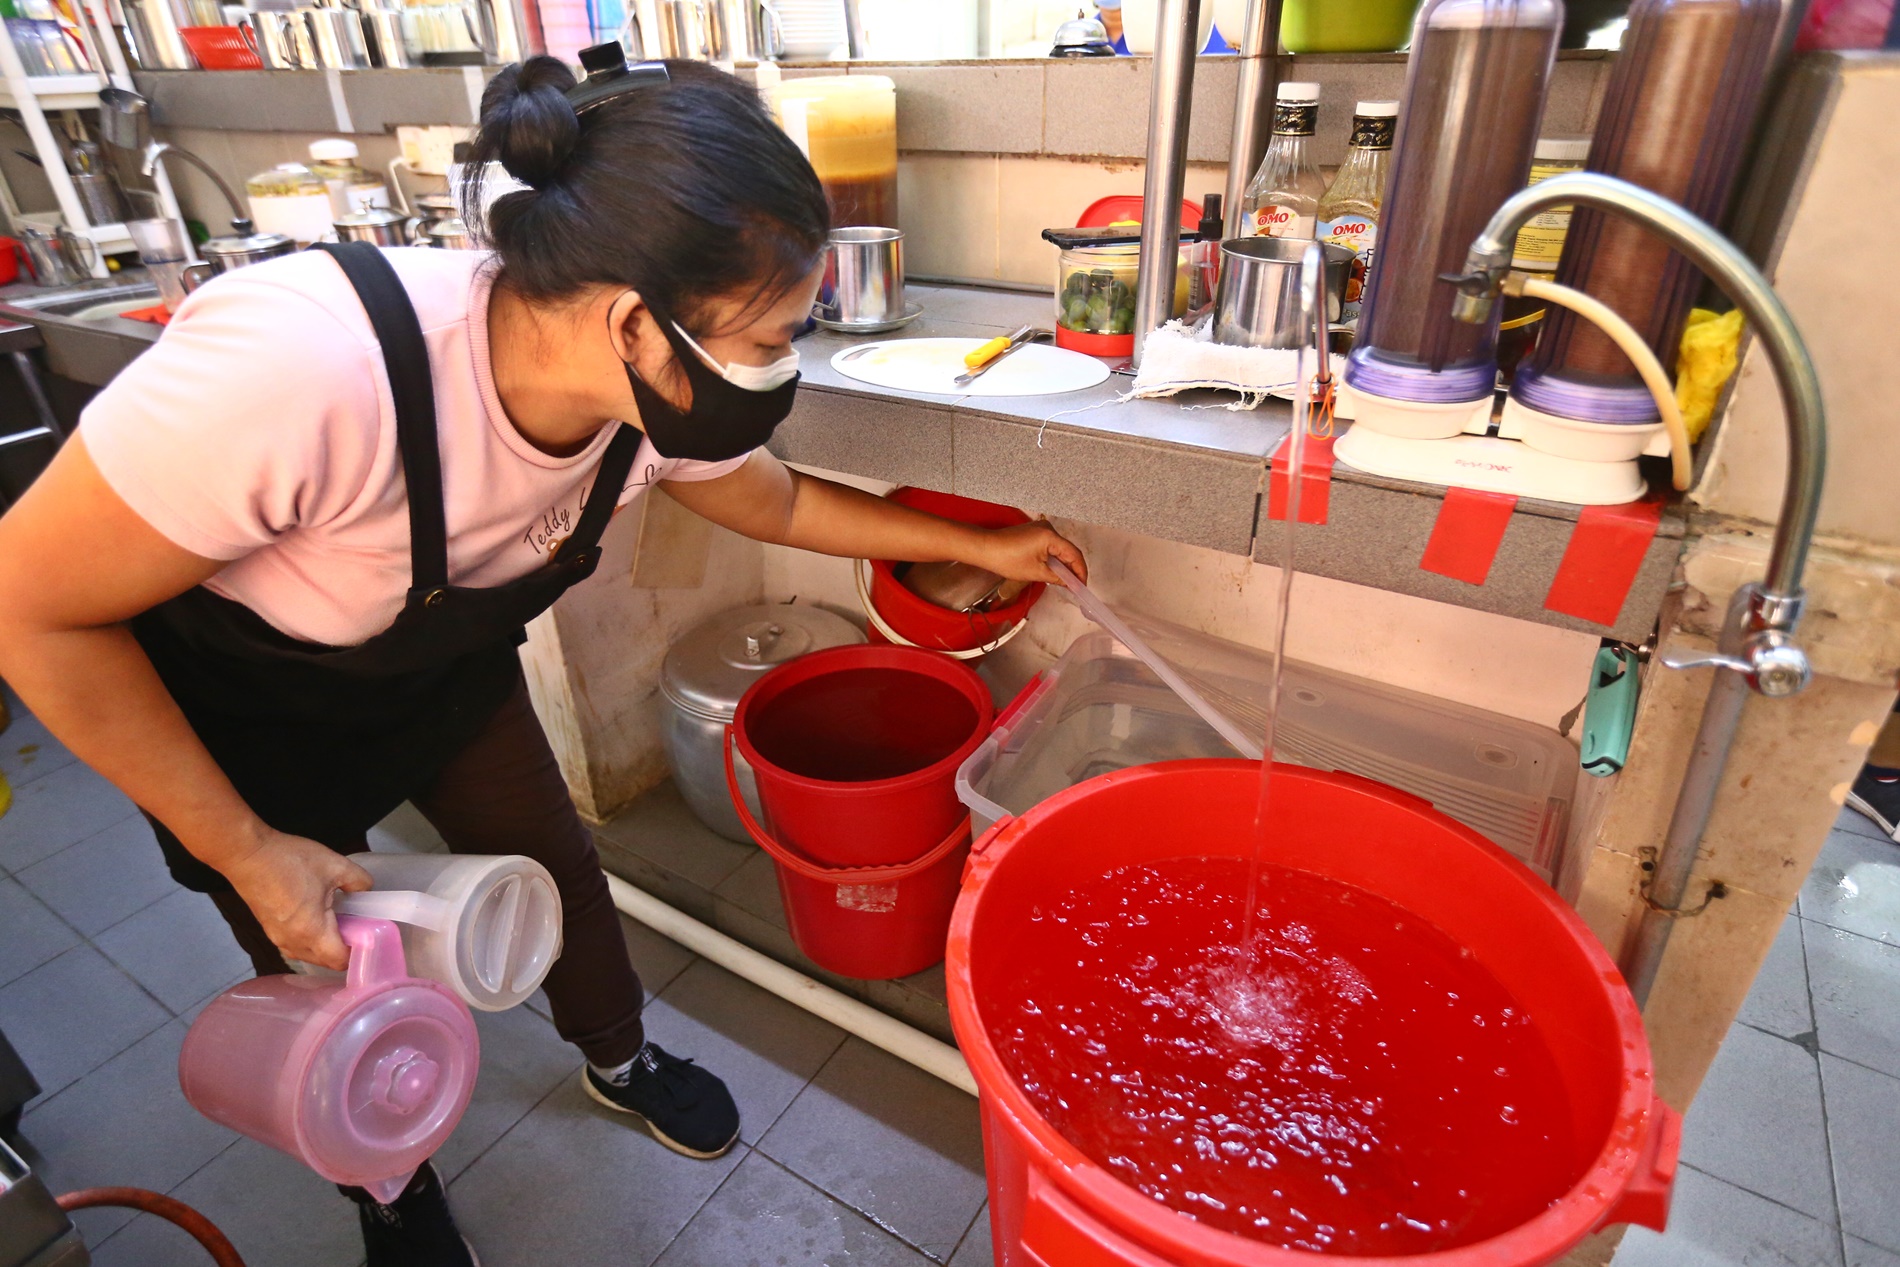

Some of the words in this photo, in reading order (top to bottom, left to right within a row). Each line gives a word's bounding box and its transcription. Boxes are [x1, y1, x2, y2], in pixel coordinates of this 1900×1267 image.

[1257, 213, 1289, 226] OMO
[1332, 223, 1366, 236] OMO
[523, 506, 571, 555] Teddy
